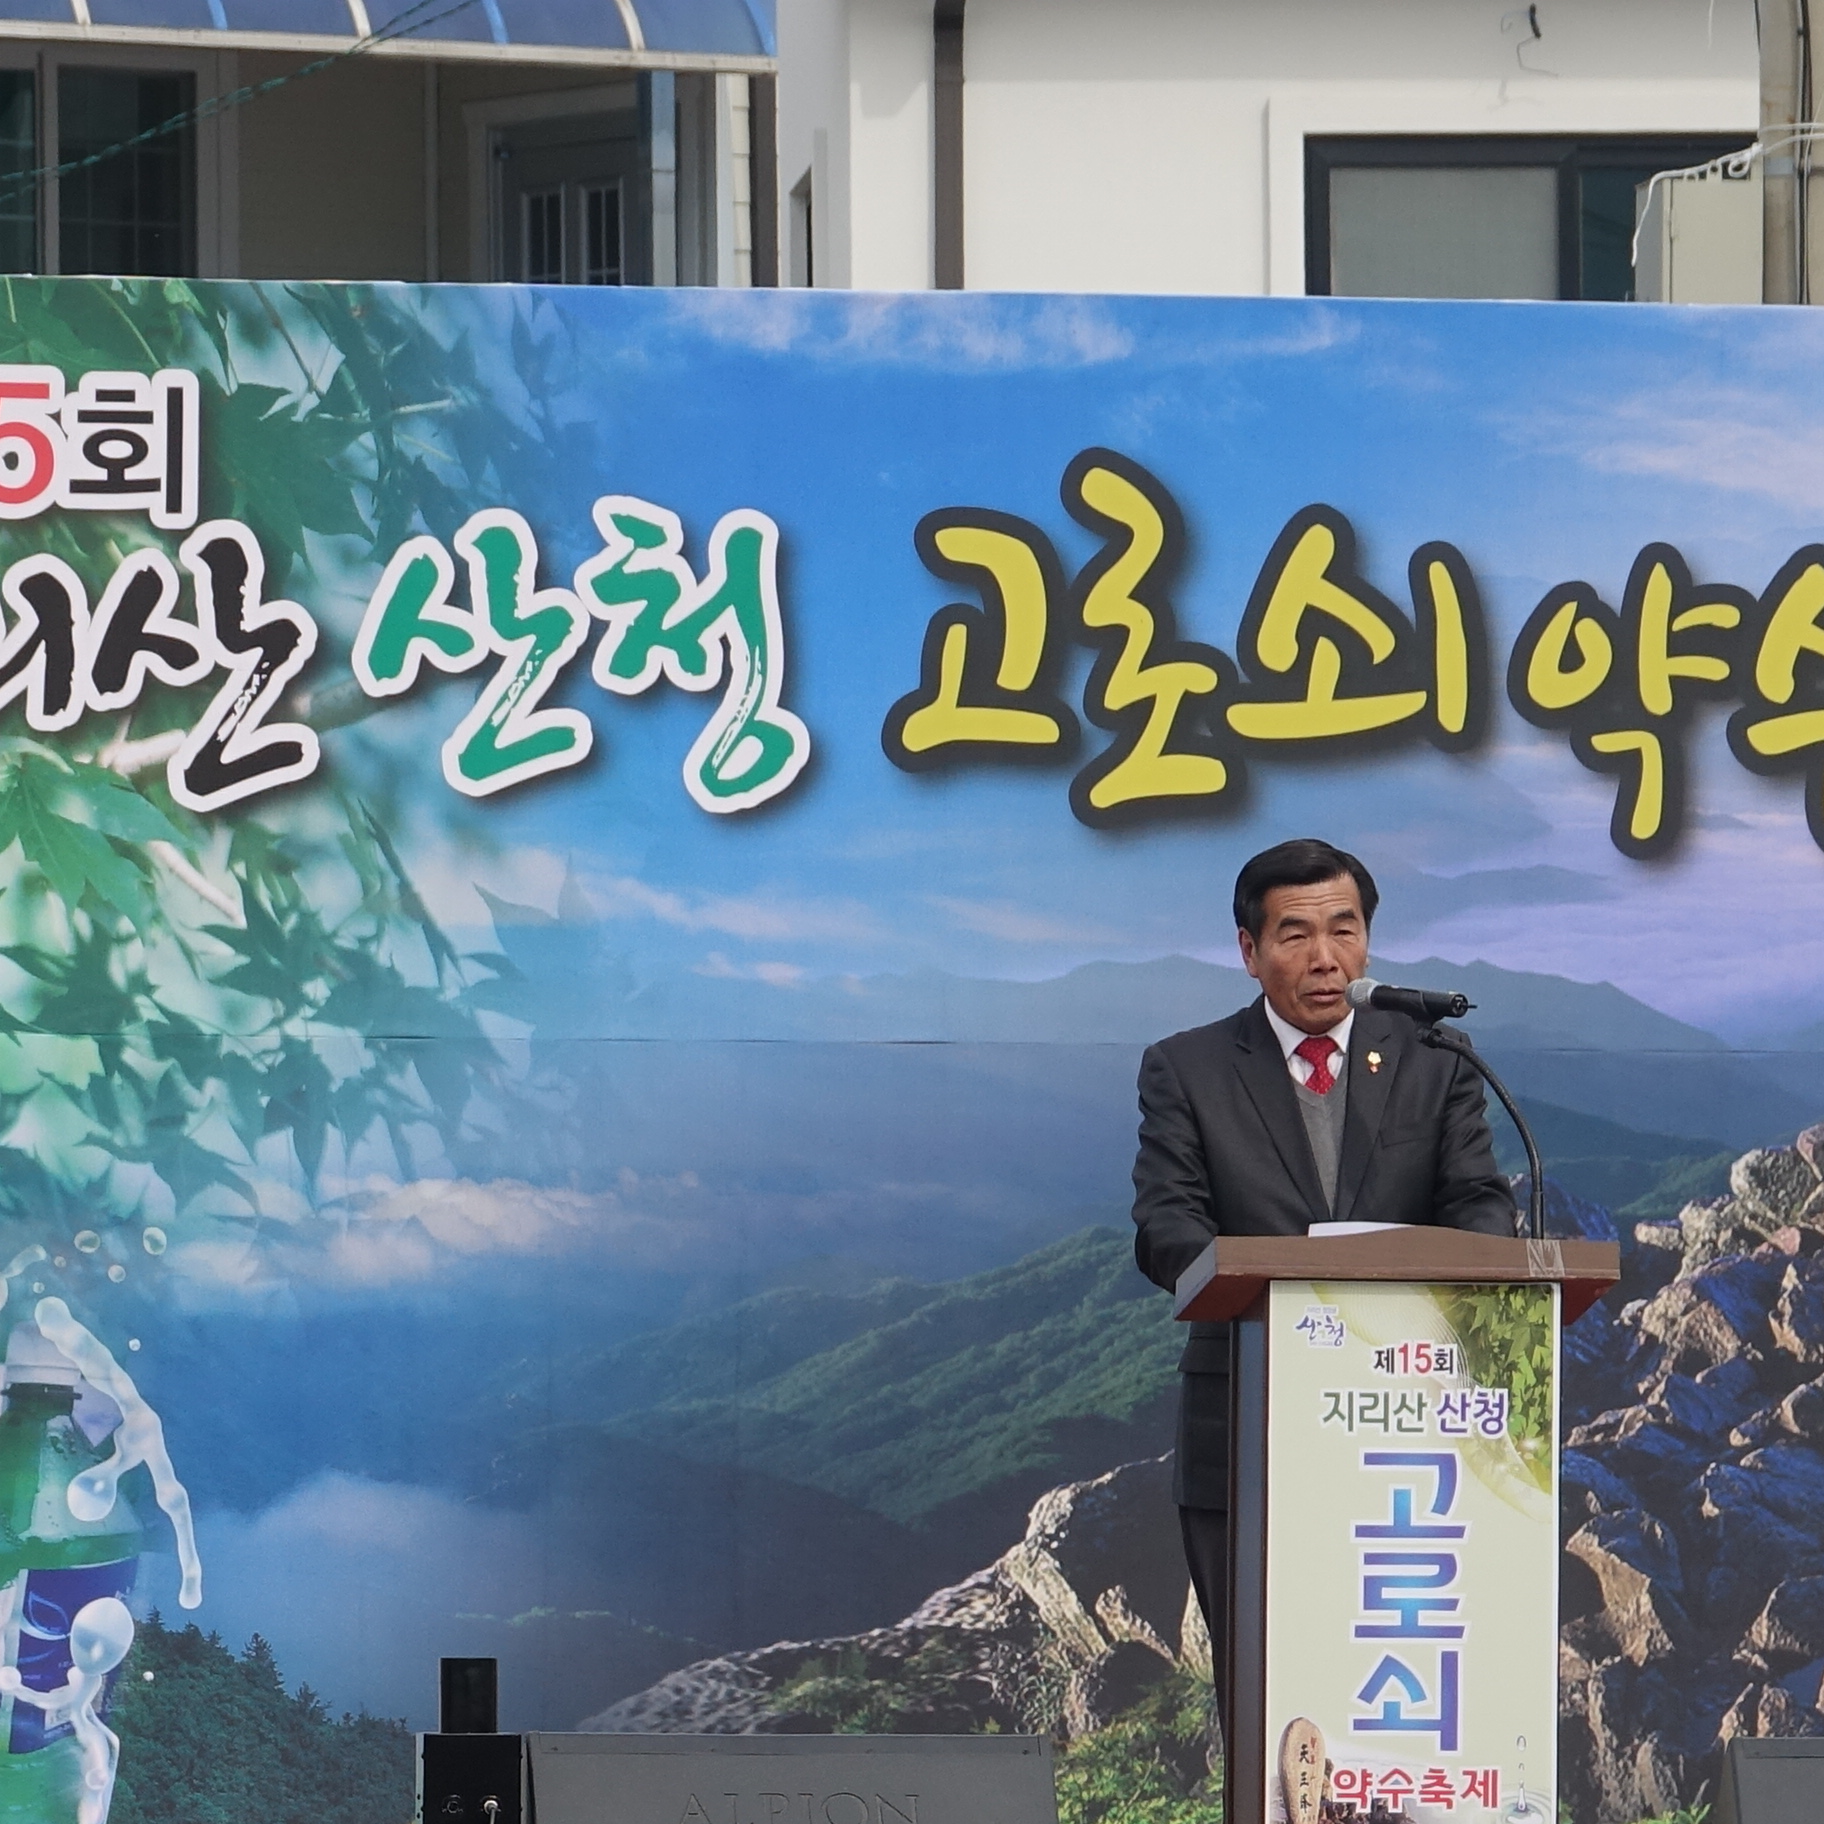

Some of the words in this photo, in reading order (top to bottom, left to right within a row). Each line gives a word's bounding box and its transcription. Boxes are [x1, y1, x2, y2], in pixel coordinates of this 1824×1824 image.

[366, 500, 798, 798] 산청
[882, 447, 1476, 827] 고로쇠
[1374, 1343, 1455, 1375] 제15회
[1322, 1390, 1426, 1433] 지리산
[1436, 1389, 1508, 1435] 산청
[1353, 1451, 1466, 1752] 고로쇠
[1333, 1768, 1498, 1809] 약수축제
